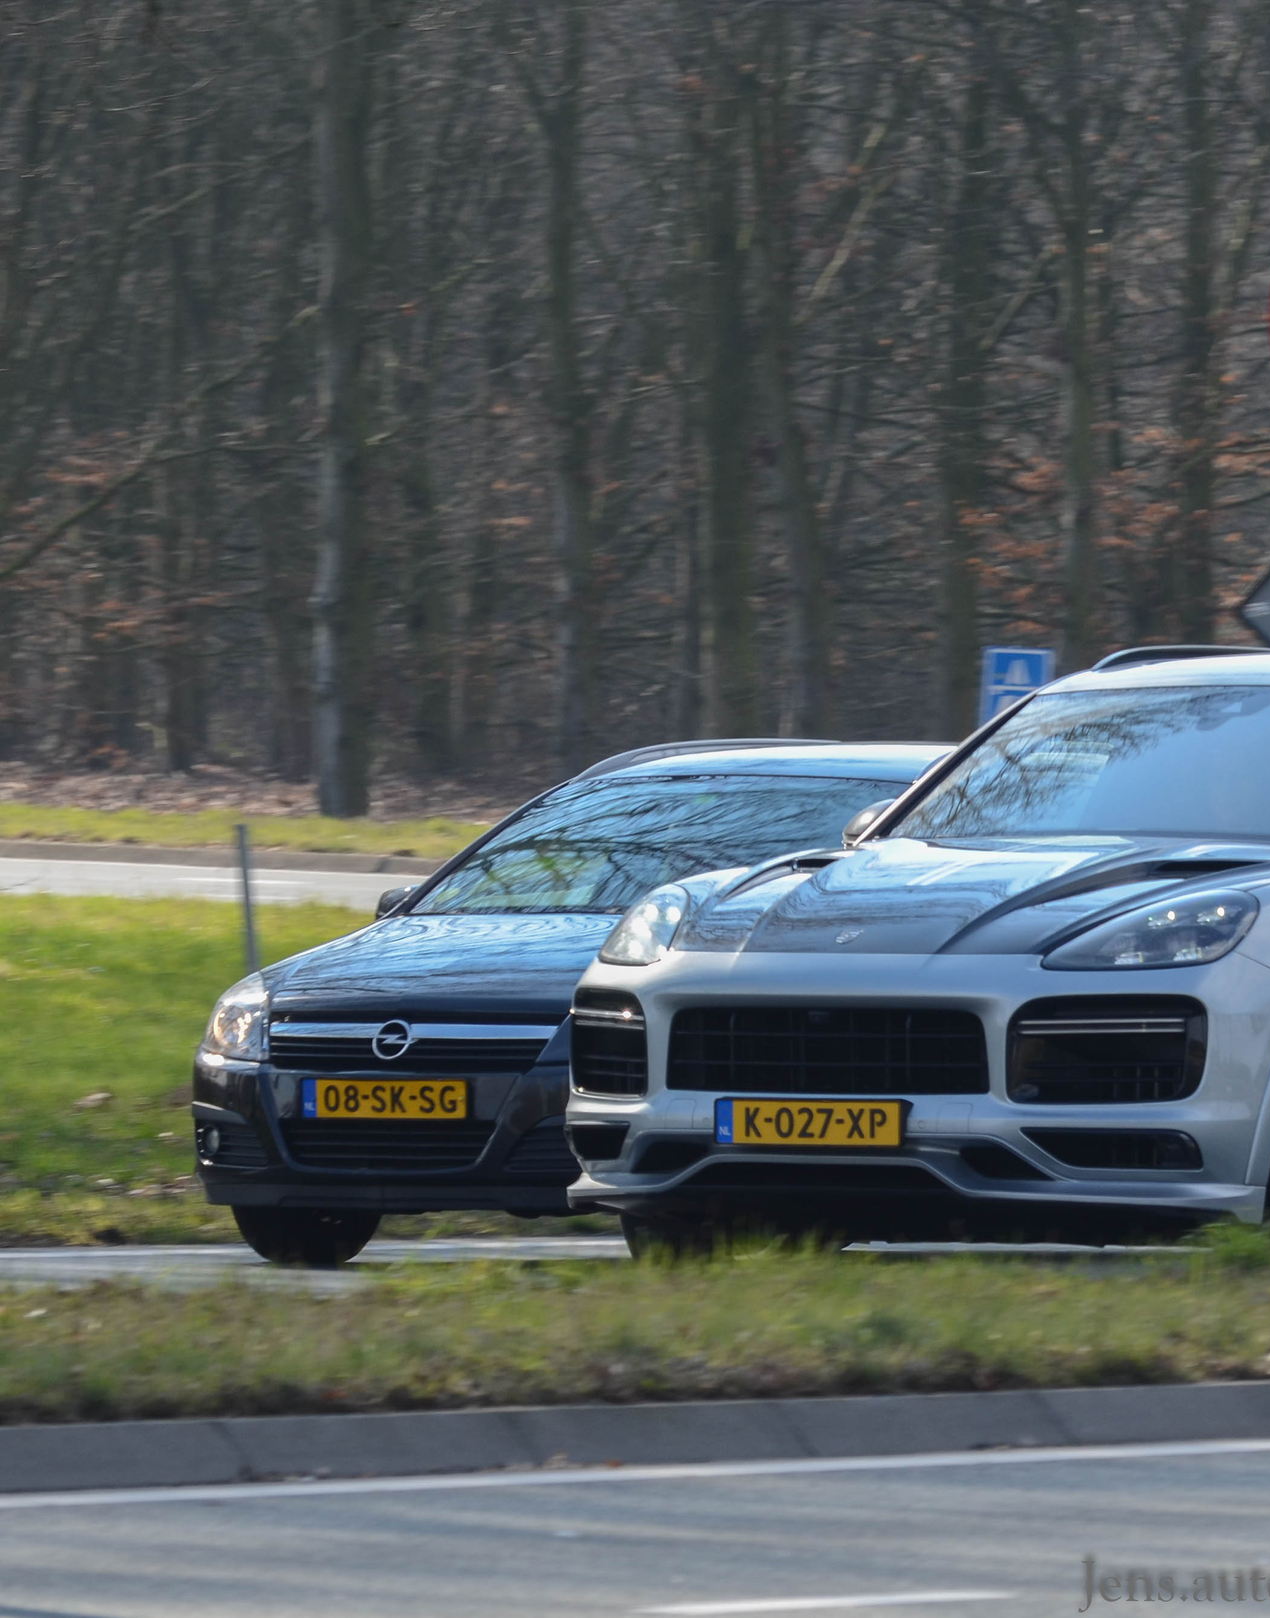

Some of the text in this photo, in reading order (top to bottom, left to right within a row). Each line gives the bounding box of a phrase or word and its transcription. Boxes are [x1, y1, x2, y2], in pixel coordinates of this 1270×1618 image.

[323, 1085, 458, 1114] 08-SK-SG
[718, 1125, 731, 1137] NL
[744, 1106, 888, 1139] K-027-XP
